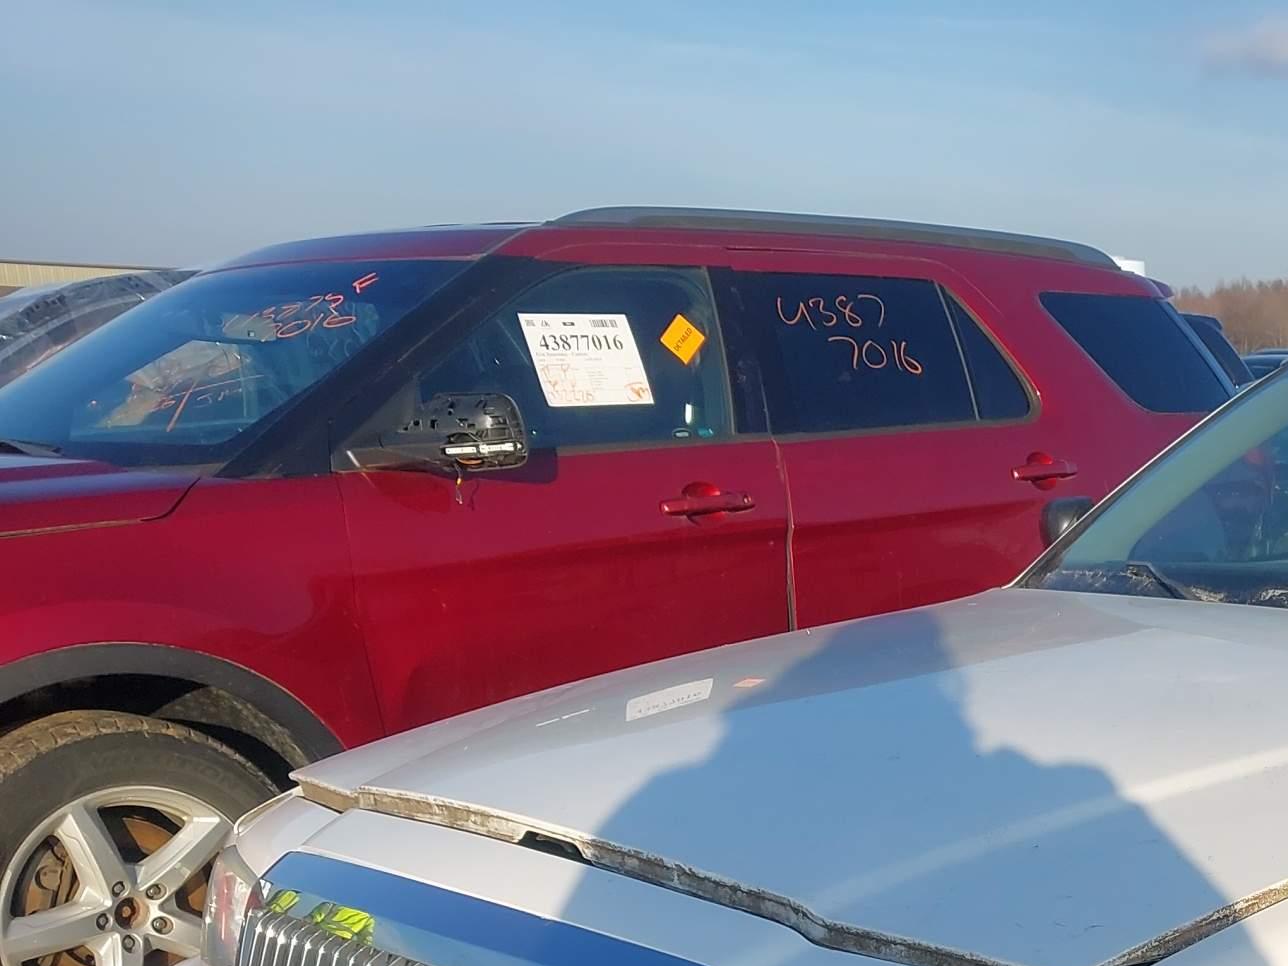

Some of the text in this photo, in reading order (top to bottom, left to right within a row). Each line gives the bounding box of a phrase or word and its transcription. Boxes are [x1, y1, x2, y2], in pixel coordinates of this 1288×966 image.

[776, 293, 885, 331] 4387
[539, 334, 624, 351] 43877016
[673, 327, 692, 352] DETAILED
[827, 336, 923, 375] 7016
